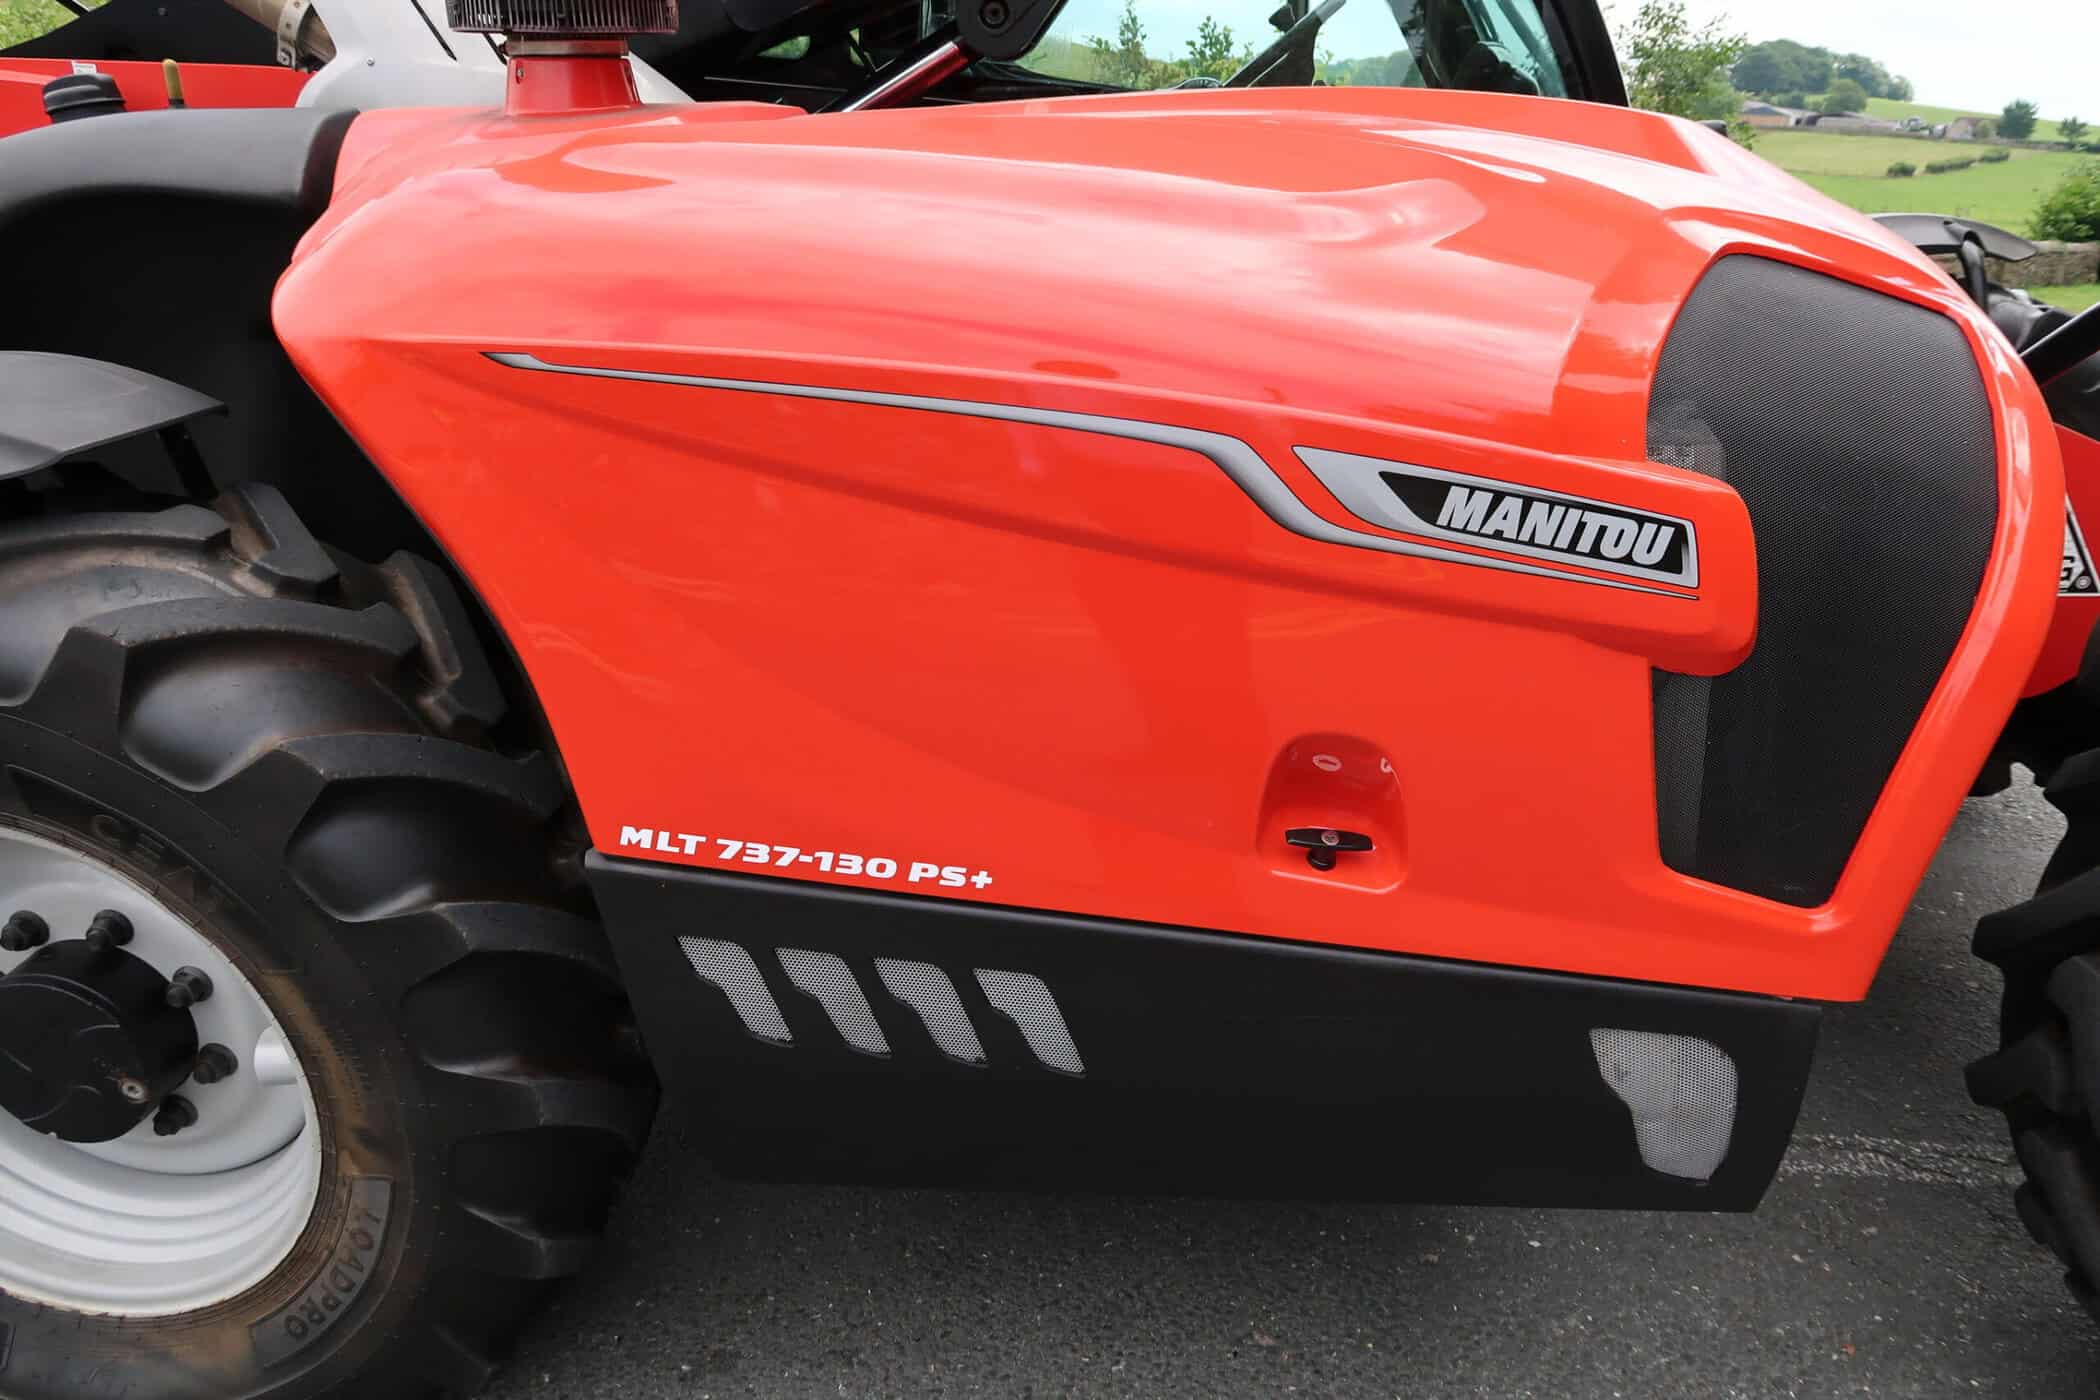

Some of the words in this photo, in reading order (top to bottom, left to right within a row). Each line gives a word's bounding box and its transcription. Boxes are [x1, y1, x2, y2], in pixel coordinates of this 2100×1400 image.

[1437, 485, 1675, 566] MANITOU
[619, 825, 706, 855] MLT
[716, 838, 897, 879] 737-130
[908, 861, 993, 889] PS+
[284, 1204, 382, 1339] LOADPRO
